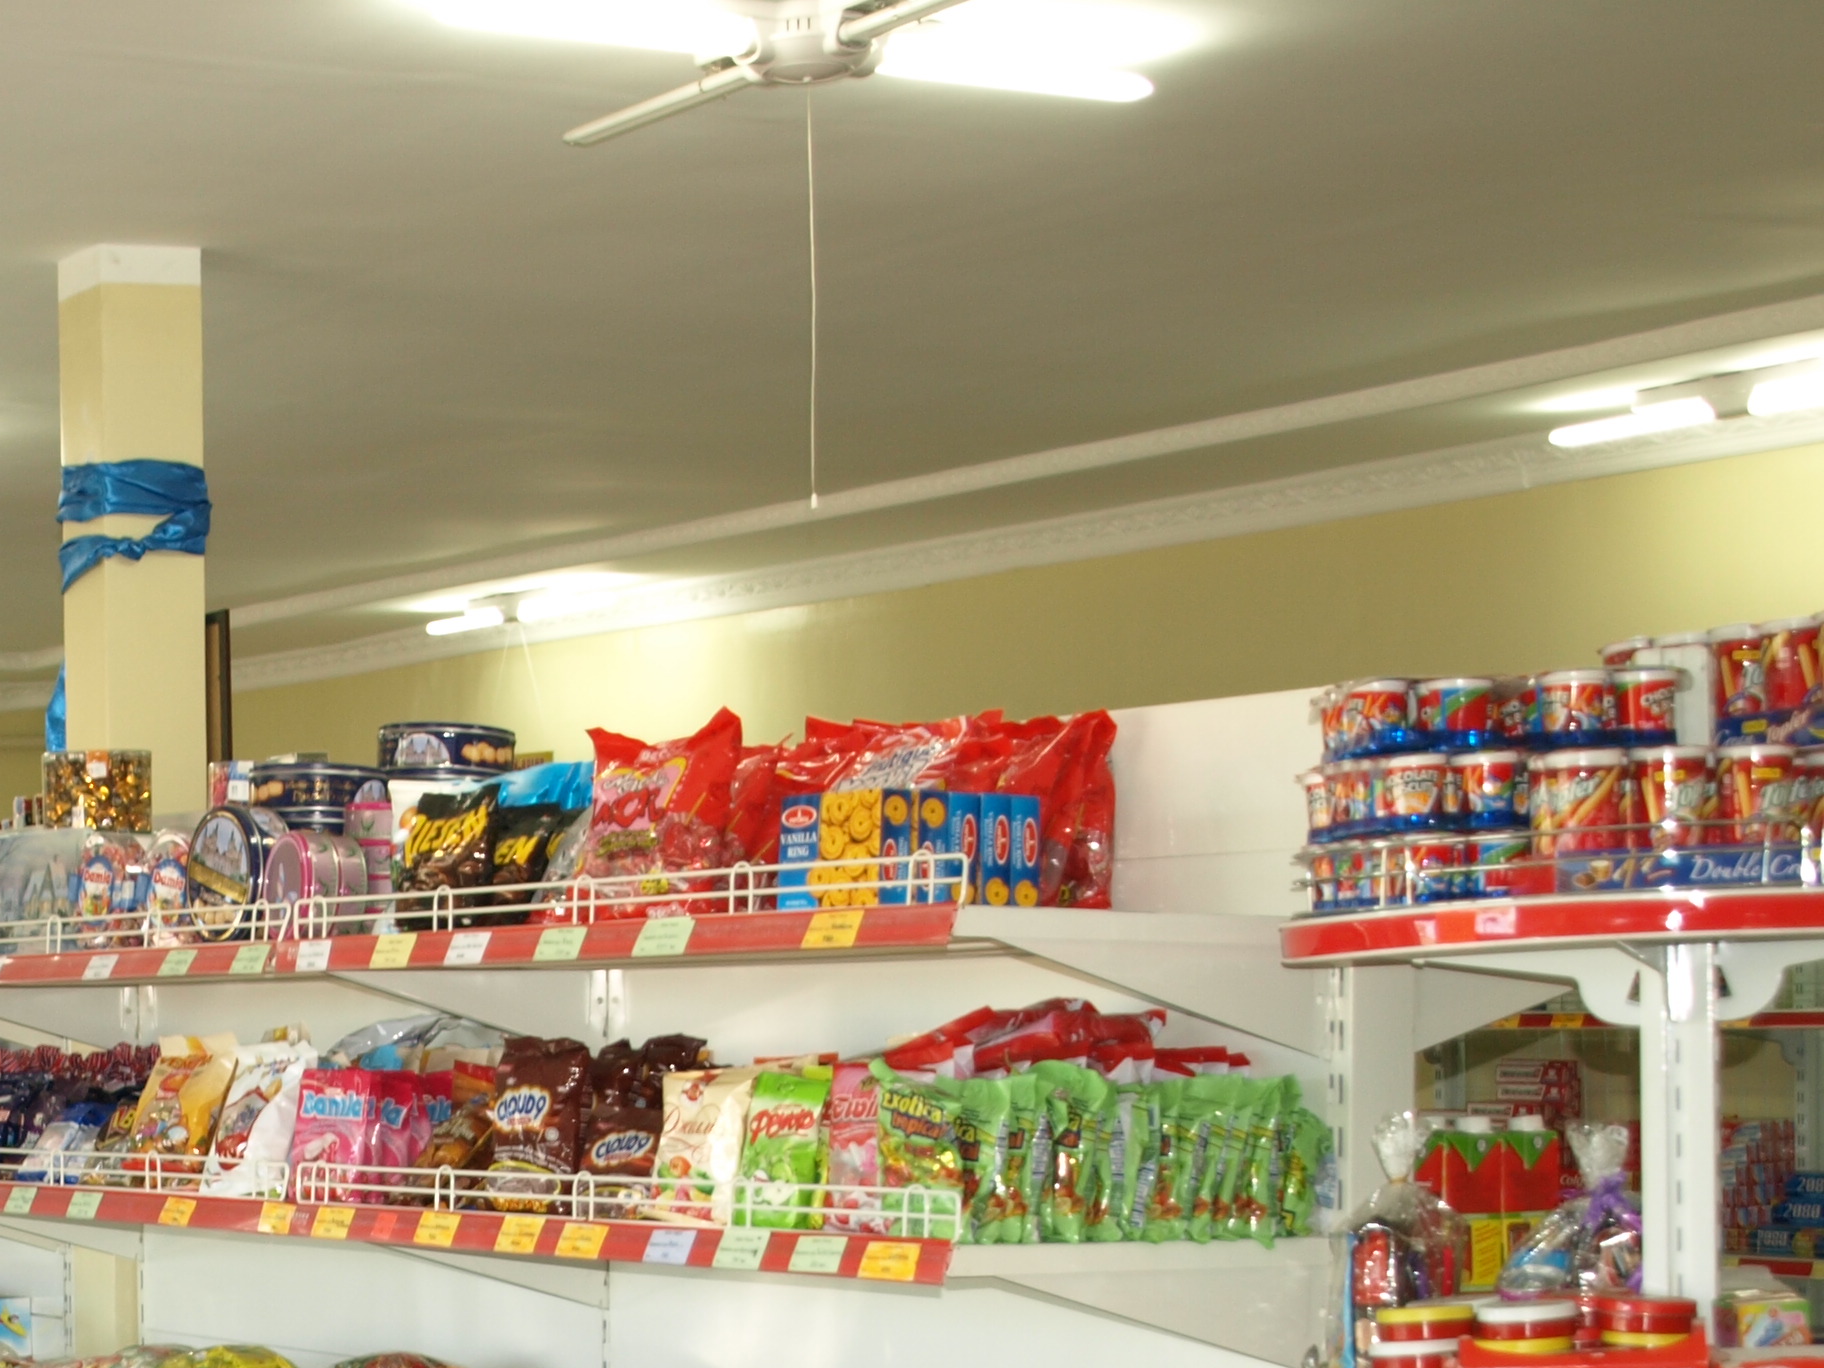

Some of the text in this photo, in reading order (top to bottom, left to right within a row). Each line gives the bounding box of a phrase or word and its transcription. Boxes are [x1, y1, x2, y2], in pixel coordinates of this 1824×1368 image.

[780, 831, 818, 846] VANILLA
[787, 845, 810, 859] RING
[1689, 851, 1762, 880] Double
